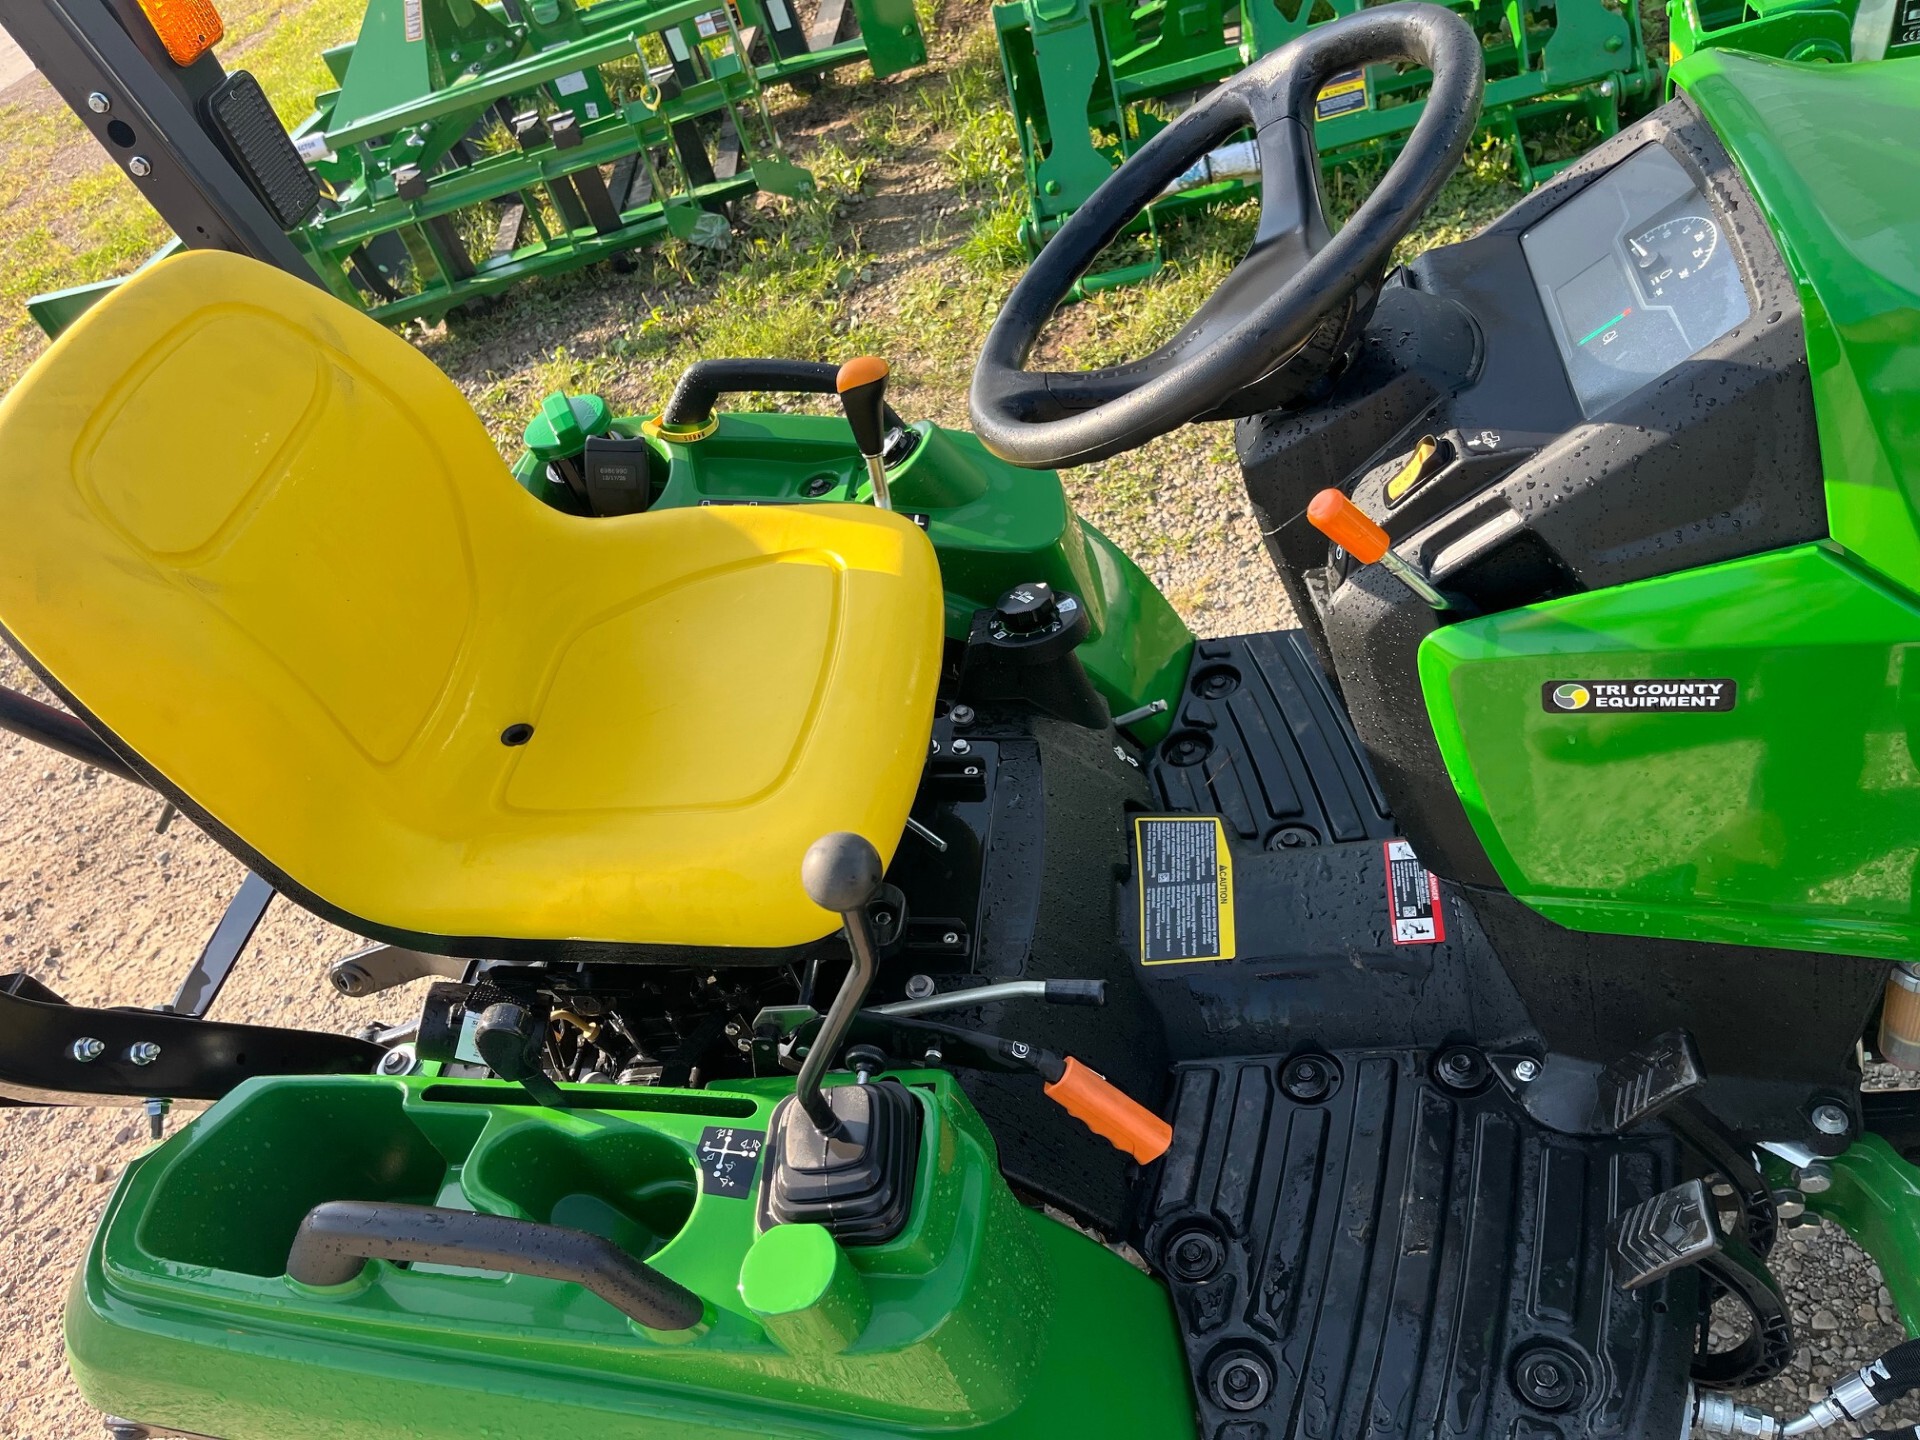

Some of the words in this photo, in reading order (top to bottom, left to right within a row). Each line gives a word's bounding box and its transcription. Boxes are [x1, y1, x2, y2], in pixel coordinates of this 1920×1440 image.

[1593, 684, 1626, 696] TRI
[1633, 683, 1724, 695] COUNTY
[1595, 696, 1721, 708] EQUIPMENT
[1220, 870, 1228, 904] CAUTION
[1429, 878, 1438, 900] DANGER
